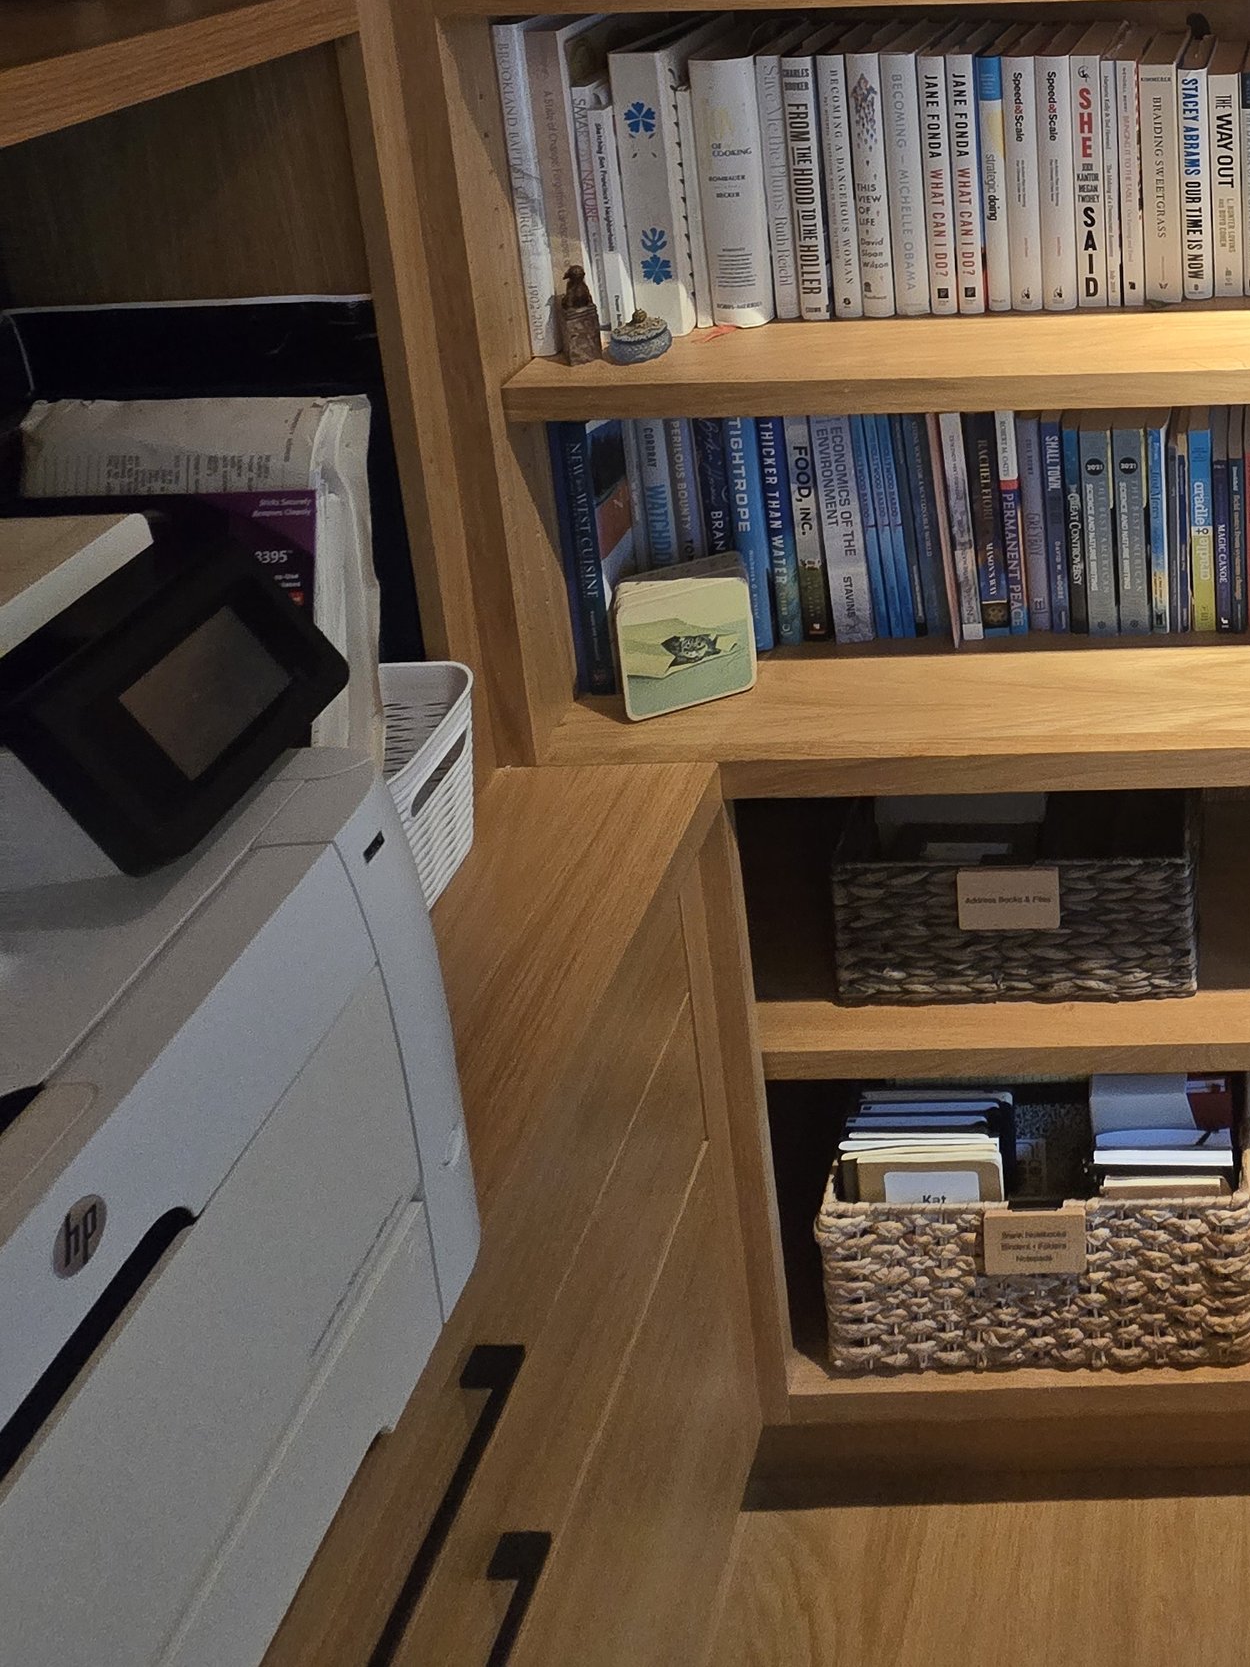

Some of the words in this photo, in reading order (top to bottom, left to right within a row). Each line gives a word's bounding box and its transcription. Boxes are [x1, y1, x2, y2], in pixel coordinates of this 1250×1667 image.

[924, 73, 940, 107] JANE
[952, 72, 967, 106] JANE
[1181, 77, 1200, 122] STACEY
[1215, 94, 1234, 109] THE
[787, 102, 810, 142] FROM
[890, 73, 907, 149] BECOMING
[1152, 96, 1165, 157] BRAIDING
[926, 112, 943, 159] FONDA
[954, 111, 970, 158] FONDA
[1183, 125, 1202, 176] ABRAMS
[1215, 112, 1234, 152] WAY
[796, 144, 813, 165] THE
[984, 152, 1000, 193] strategic
[1216, 154, 1236, 189] OUT
[797, 166, 815, 204] HOOD
[857, 183, 877, 192] THIS
[897, 167, 914, 235] MICHELLE
[929, 167, 946, 206] WHAT
[957, 166, 973, 205] WHAT
[1155, 159, 1168, 239] SWEETGRASS
[1185, 180, 1203, 204] OUR
[801, 207, 818, 219] TO
[931, 211, 948, 241] CAN
[959, 210, 975, 237] CAN
[986, 193, 1001, 221] doing
[1185, 206, 1203, 235] TIME
[802, 221, 818, 241] THE
[860, 237, 884, 246] David
[1186, 239, 1203, 251] IS
[799, 243, 822, 295] HOLLER
[902, 241, 918, 291] OBAMA
[934, 250, 950, 278] DO?
[961, 250, 977, 276] DO?
[1187, 254, 1205, 281] NOW
[760, 421, 775, 485] THICKER
[830, 426, 851, 507] ECONOMICS
[728, 417, 751, 533] TIGHTROPE
[816, 427, 839, 528] ENVIRONMENT
[767, 490, 783, 529] THAN
[842, 510, 853, 528] OF
[844, 530, 857, 557] THE
[1002, 493, 1021, 581] PERMANENT
[1217, 524, 1228, 552] MAGIC
[771, 534, 788, 585] WATER
[1218, 553, 1229, 583] CANOE
[1008, 583, 1025, 626] PEACE
[964, 895, 997, 905] Address
[922, 1194, 947, 1203] Kat
[64, 1204, 97, 1268] hp
